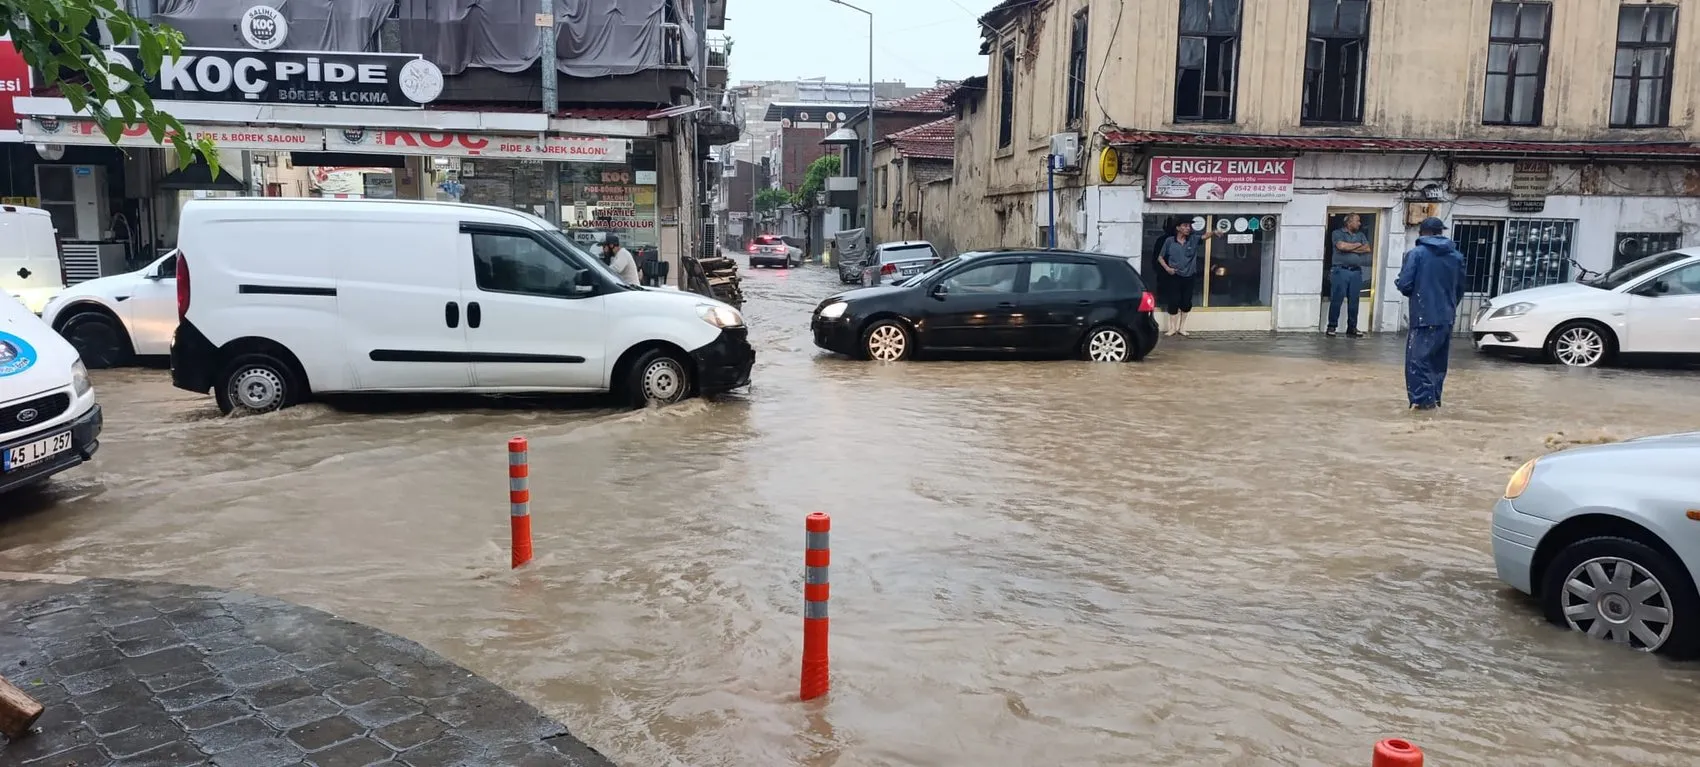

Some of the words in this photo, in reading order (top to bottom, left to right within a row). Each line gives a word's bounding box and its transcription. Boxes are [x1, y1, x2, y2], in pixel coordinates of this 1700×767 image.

[252, 19, 274, 31] KOÇ
[160, 55, 268, 99] KOÇ
[275, 57, 388, 83] PİDE
[279, 88, 324, 101] BÖREK
[329, 91, 338, 101] &
[342, 91, 389, 104] LOKMA
[231, 132, 264, 142] BÖREK
[266, 133, 306, 143] SALONU
[500, 143, 522, 153] PİDE
[525, 144, 532, 153] &
[570, 146, 608, 155] SALONU
[1227, 160, 1286, 174] EMLAK
[601, 172, 629, 184] KOÇ
[577, 220, 609, 228] LOKMA
[11, 448, 25, 465] 45
[34, 441, 46, 459] LJ
[53, 432, 70, 452] 257
